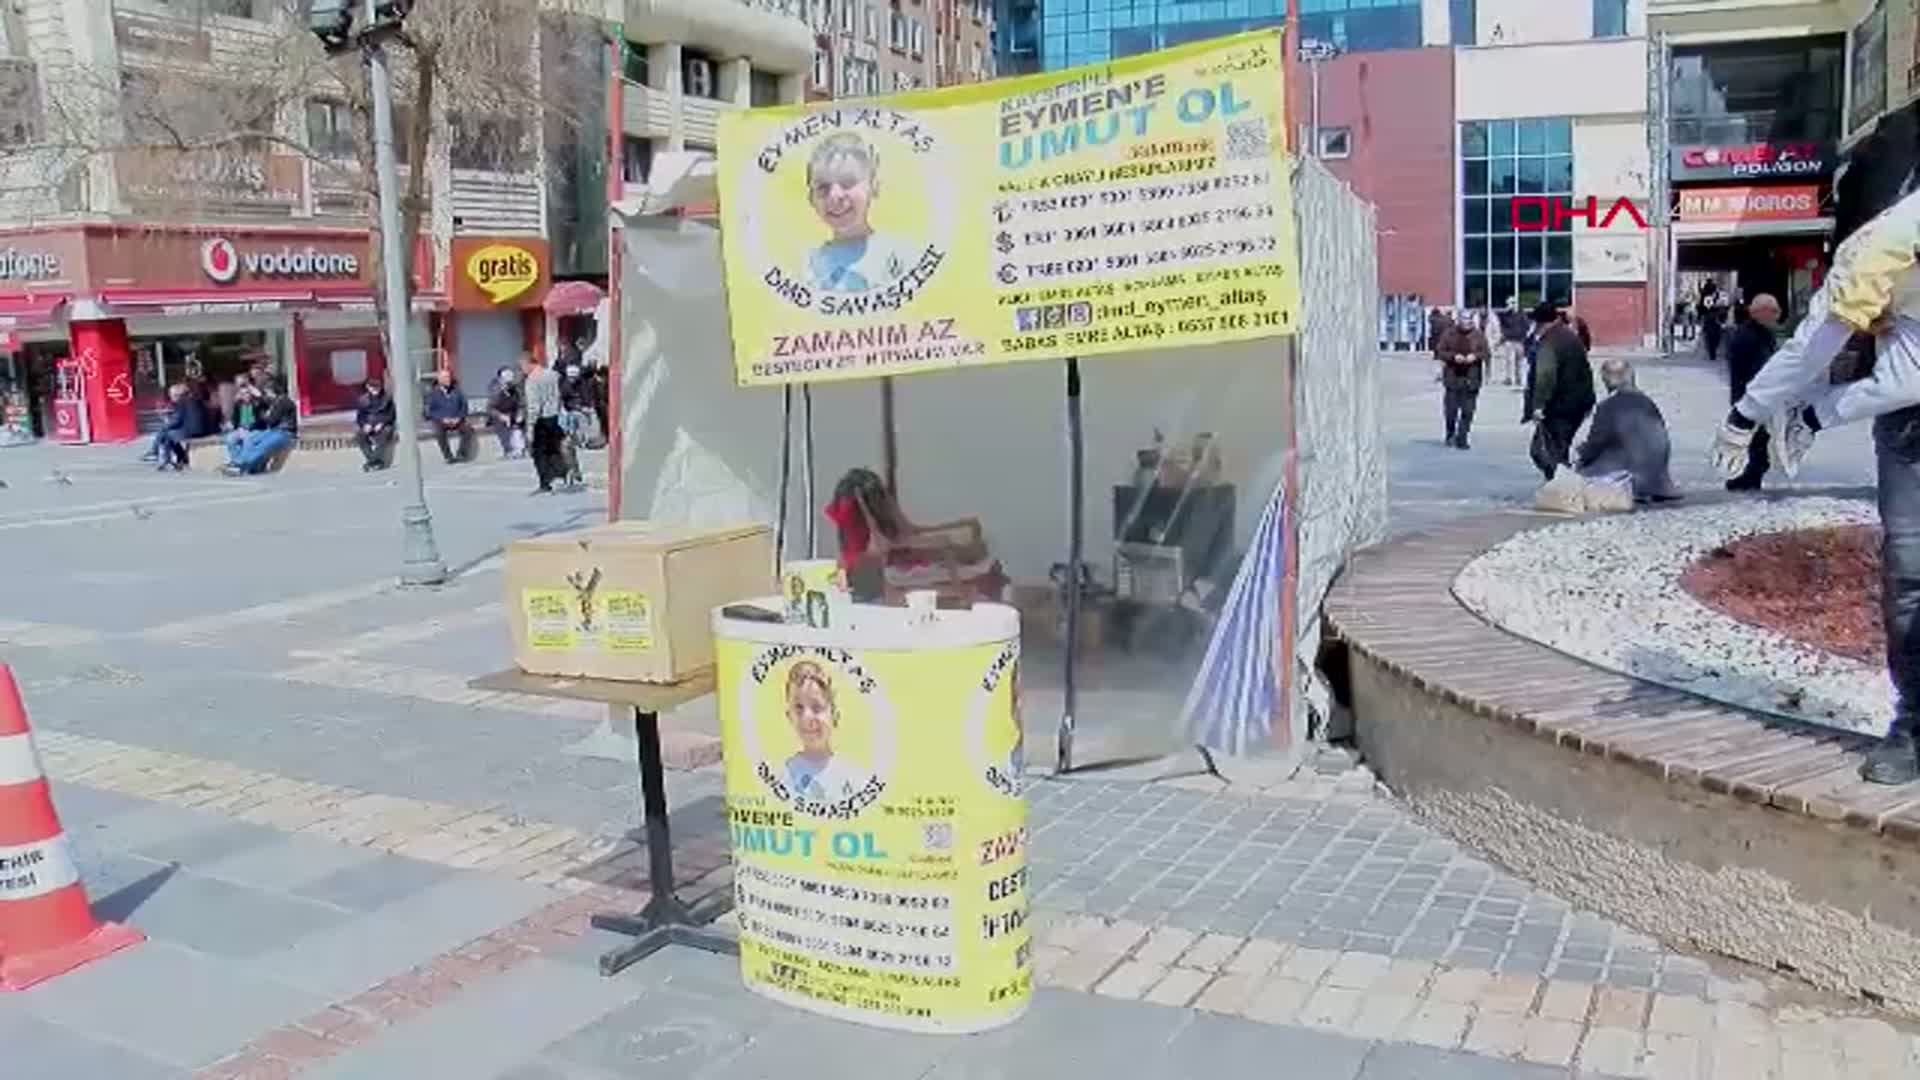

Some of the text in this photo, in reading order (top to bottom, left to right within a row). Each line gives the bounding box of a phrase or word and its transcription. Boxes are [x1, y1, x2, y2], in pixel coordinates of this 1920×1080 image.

[1000, 74, 1166, 138] EYMEN'E
[1001, 81, 1251, 170] UMUT OL
[756, 108, 841, 174] EYMEN
[1685, 197, 1721, 212] MM
[245, 247, 358, 277] vodafone
[479, 252, 532, 284] gratis
[764, 266, 811, 308] DMD
[773, 318, 958, 357] ZAMANIM AZ
[832, 830, 888, 860] OL
